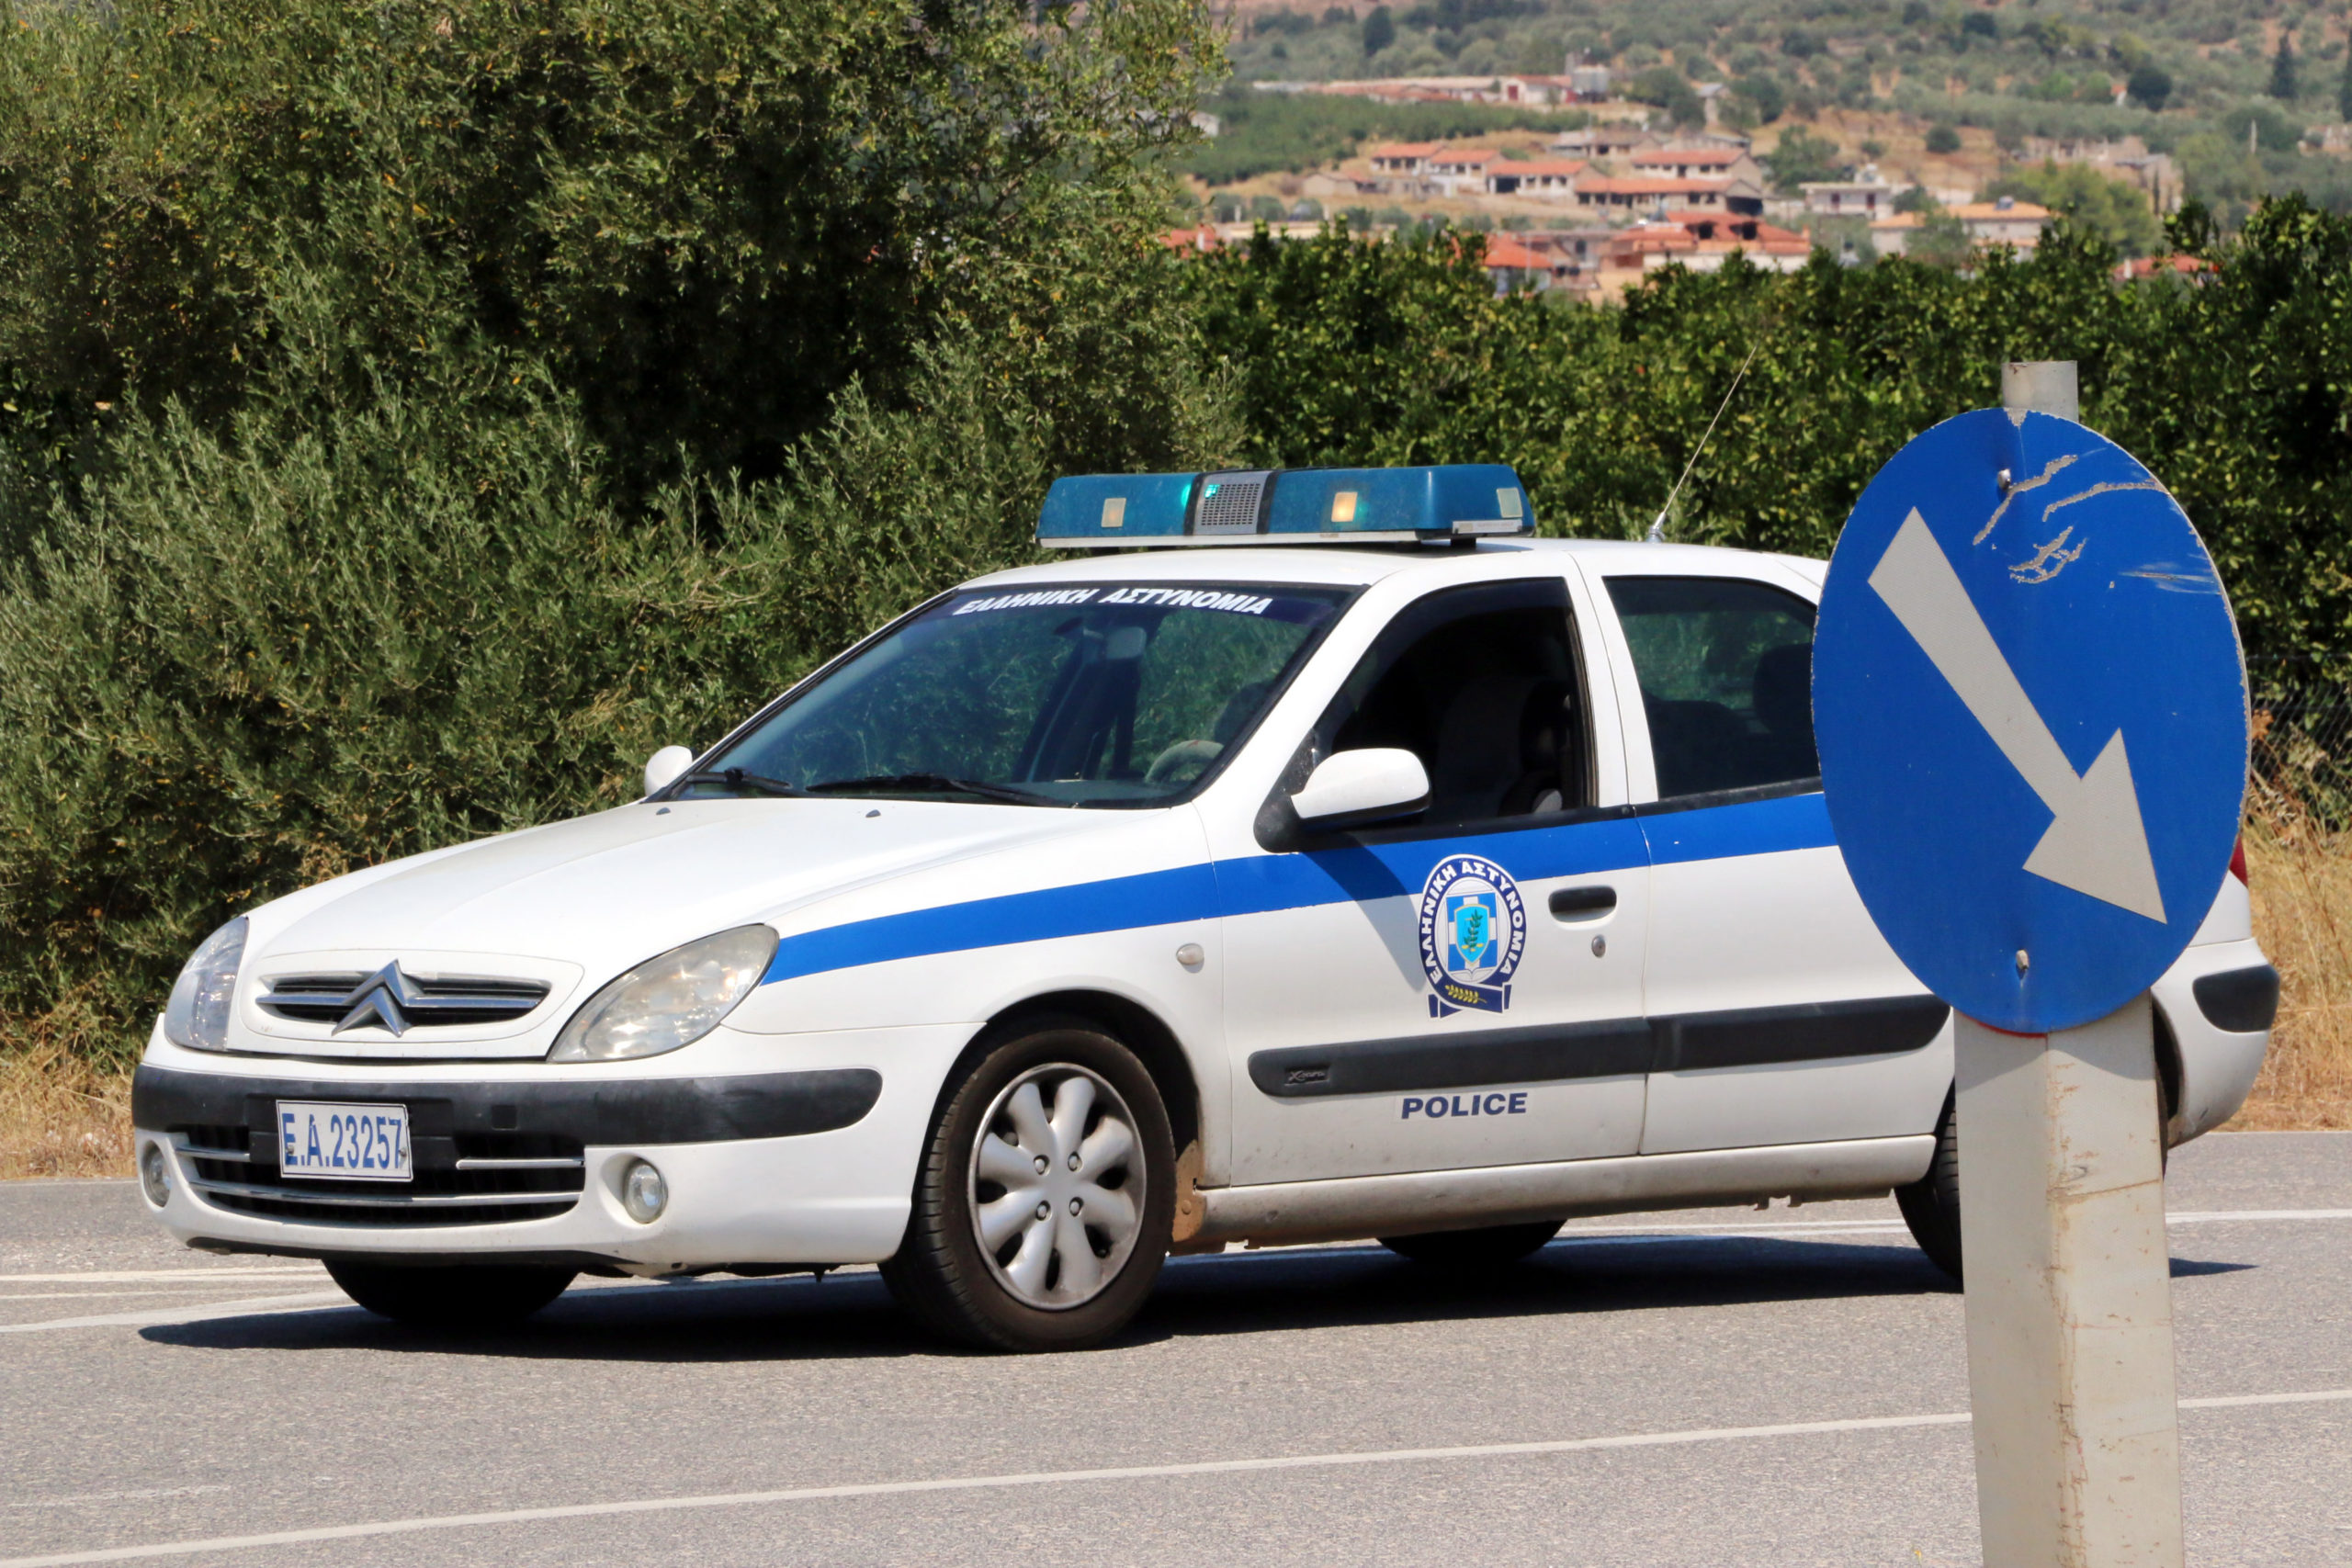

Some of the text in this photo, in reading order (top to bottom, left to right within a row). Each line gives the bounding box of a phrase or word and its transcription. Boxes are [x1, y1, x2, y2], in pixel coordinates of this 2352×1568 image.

[952, 588, 1272, 615] ΕΛΛΗΝΙΚΗ ΑΣΤΥΝΟΜΙΑ
[1421, 861, 1524, 985] ΕΛΛΗΝΙΚΗ ΑΣΤΥΝΟΜΙΑ
[1401, 1092, 1528, 1120] POLICE
